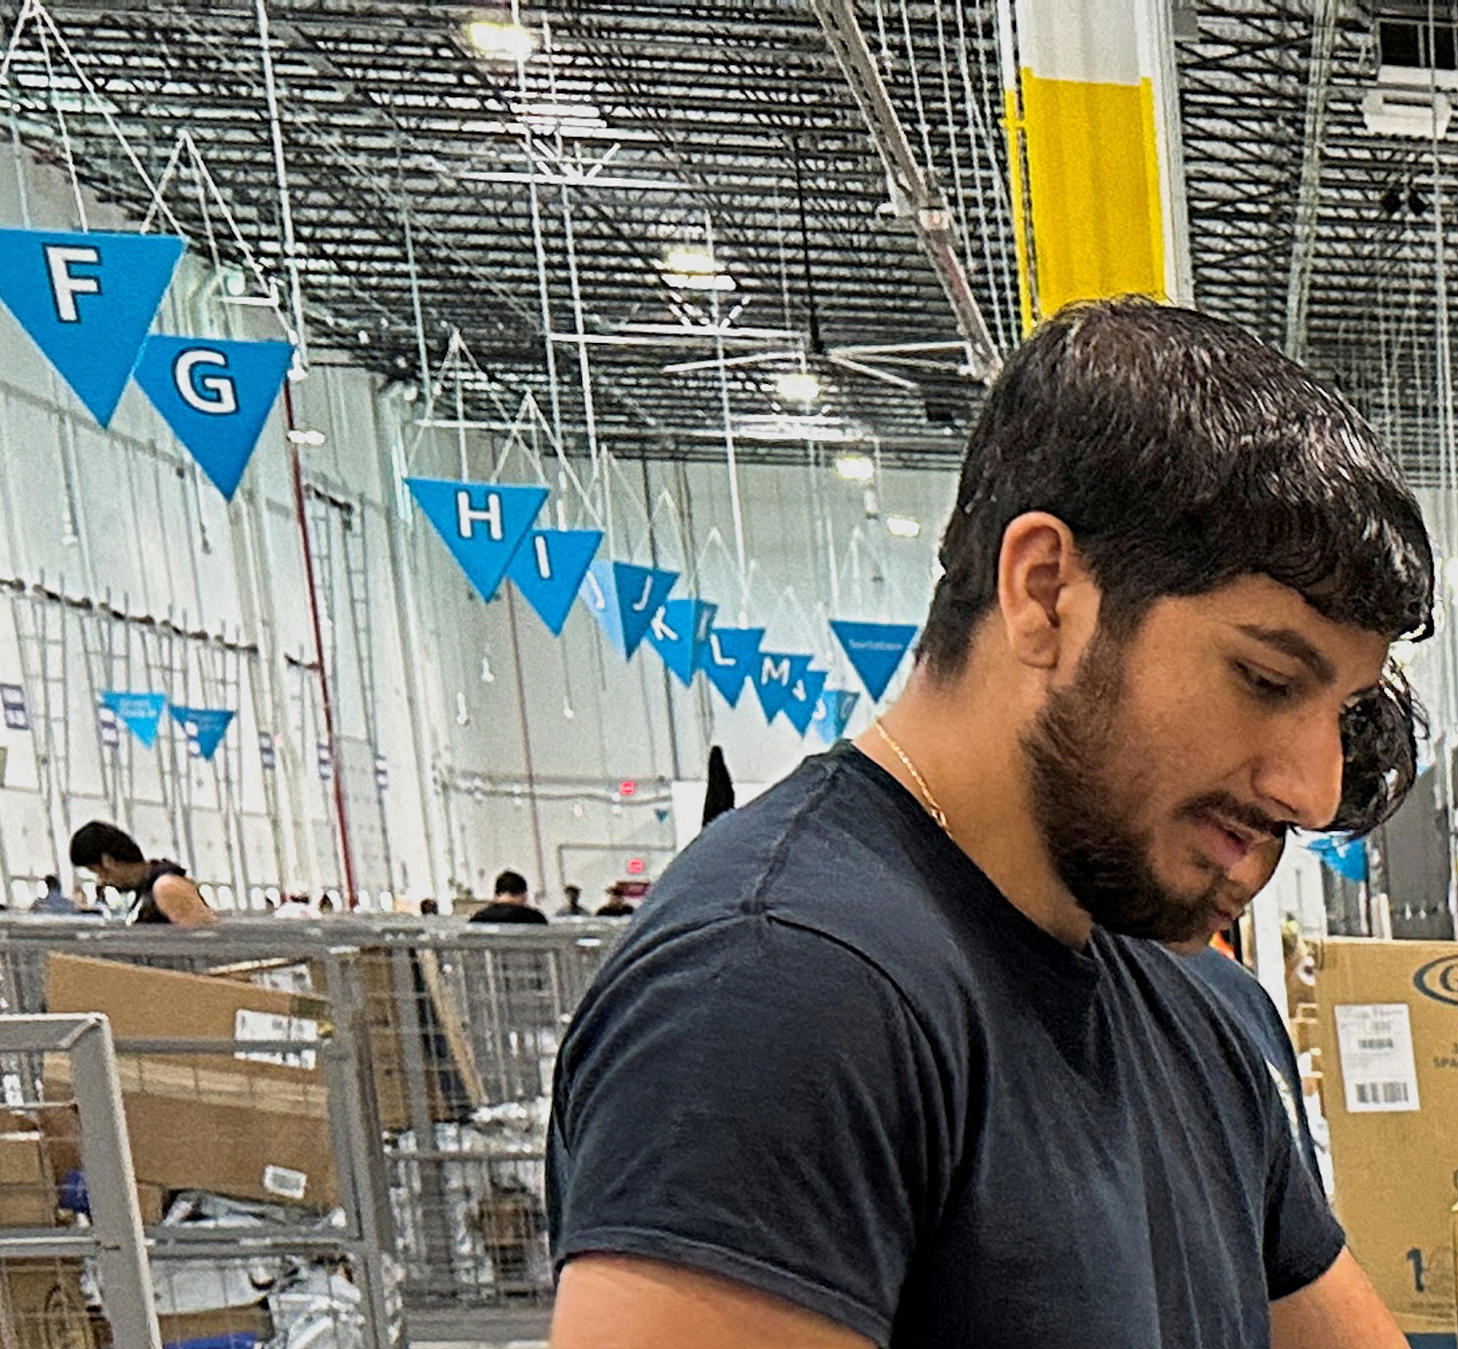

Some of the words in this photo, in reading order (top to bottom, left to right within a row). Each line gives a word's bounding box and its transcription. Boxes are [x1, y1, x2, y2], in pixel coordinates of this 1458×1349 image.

[50, 245, 104, 322] F
[173, 349, 236, 416] G
[457, 491, 503, 542] H
[533, 534, 553, 579] I
[651, 605, 679, 641] K
[709, 633, 736, 667] L
[760, 657, 790, 686] M
